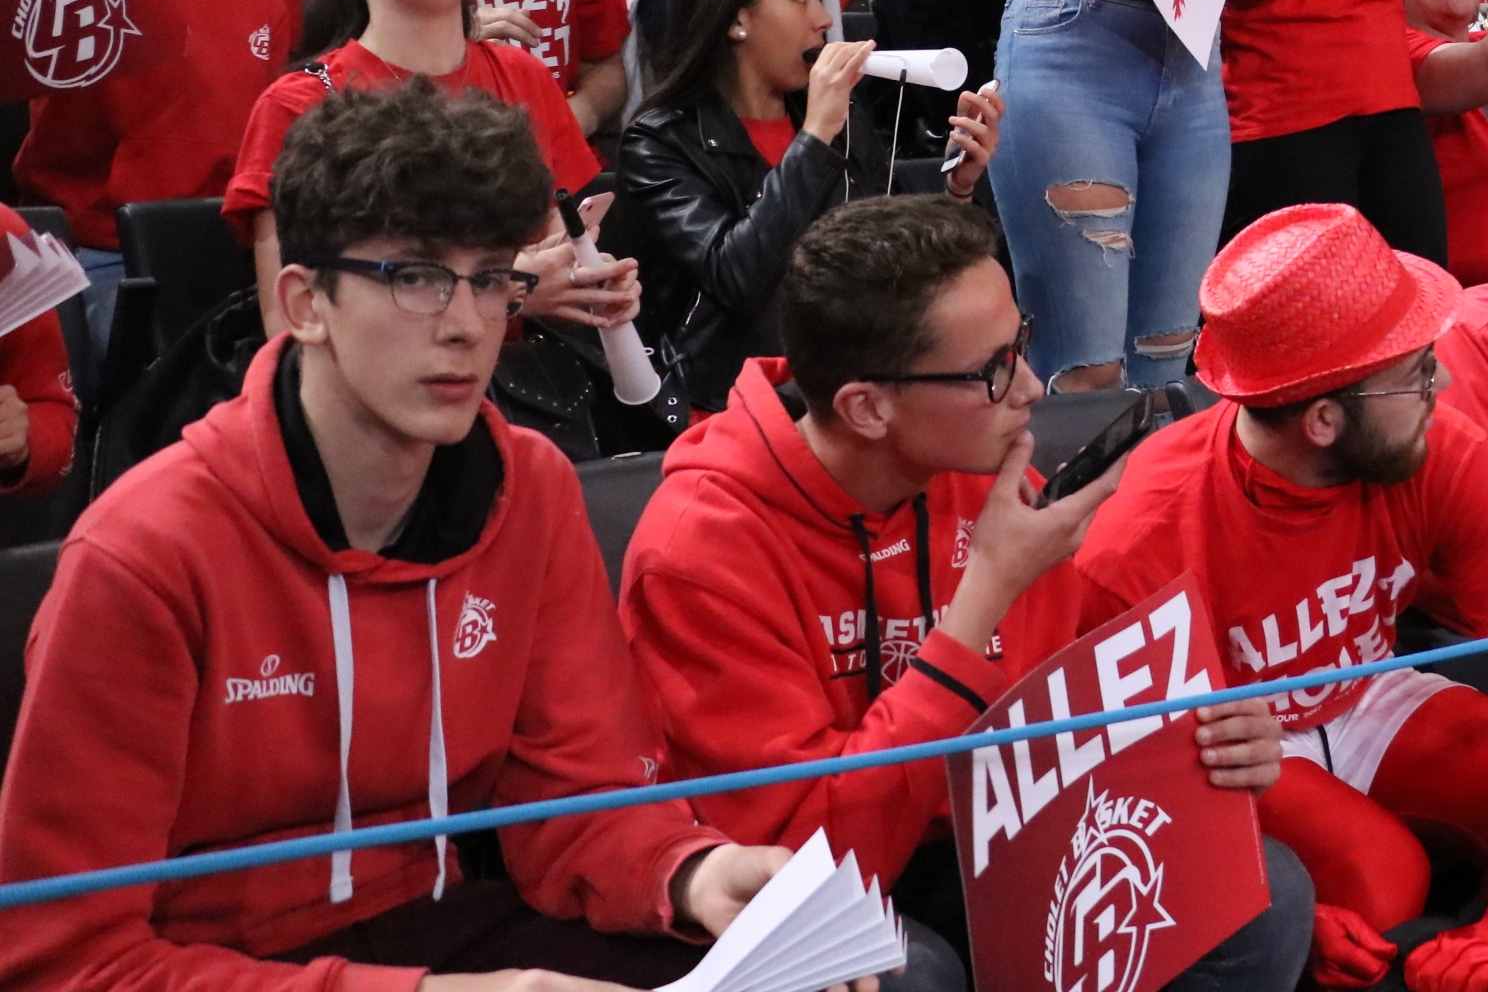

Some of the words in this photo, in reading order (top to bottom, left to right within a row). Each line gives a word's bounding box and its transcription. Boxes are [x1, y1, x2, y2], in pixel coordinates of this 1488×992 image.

[859, 538, 911, 562] ALDING
[1229, 555, 1377, 673] ALLEZ
[225, 672, 316, 705] SPALDING
[972, 590, 1213, 879] ALLEZ
[1044, 856, 1069, 983] CHOLET
[1071, 793, 1173, 860] BASKET
